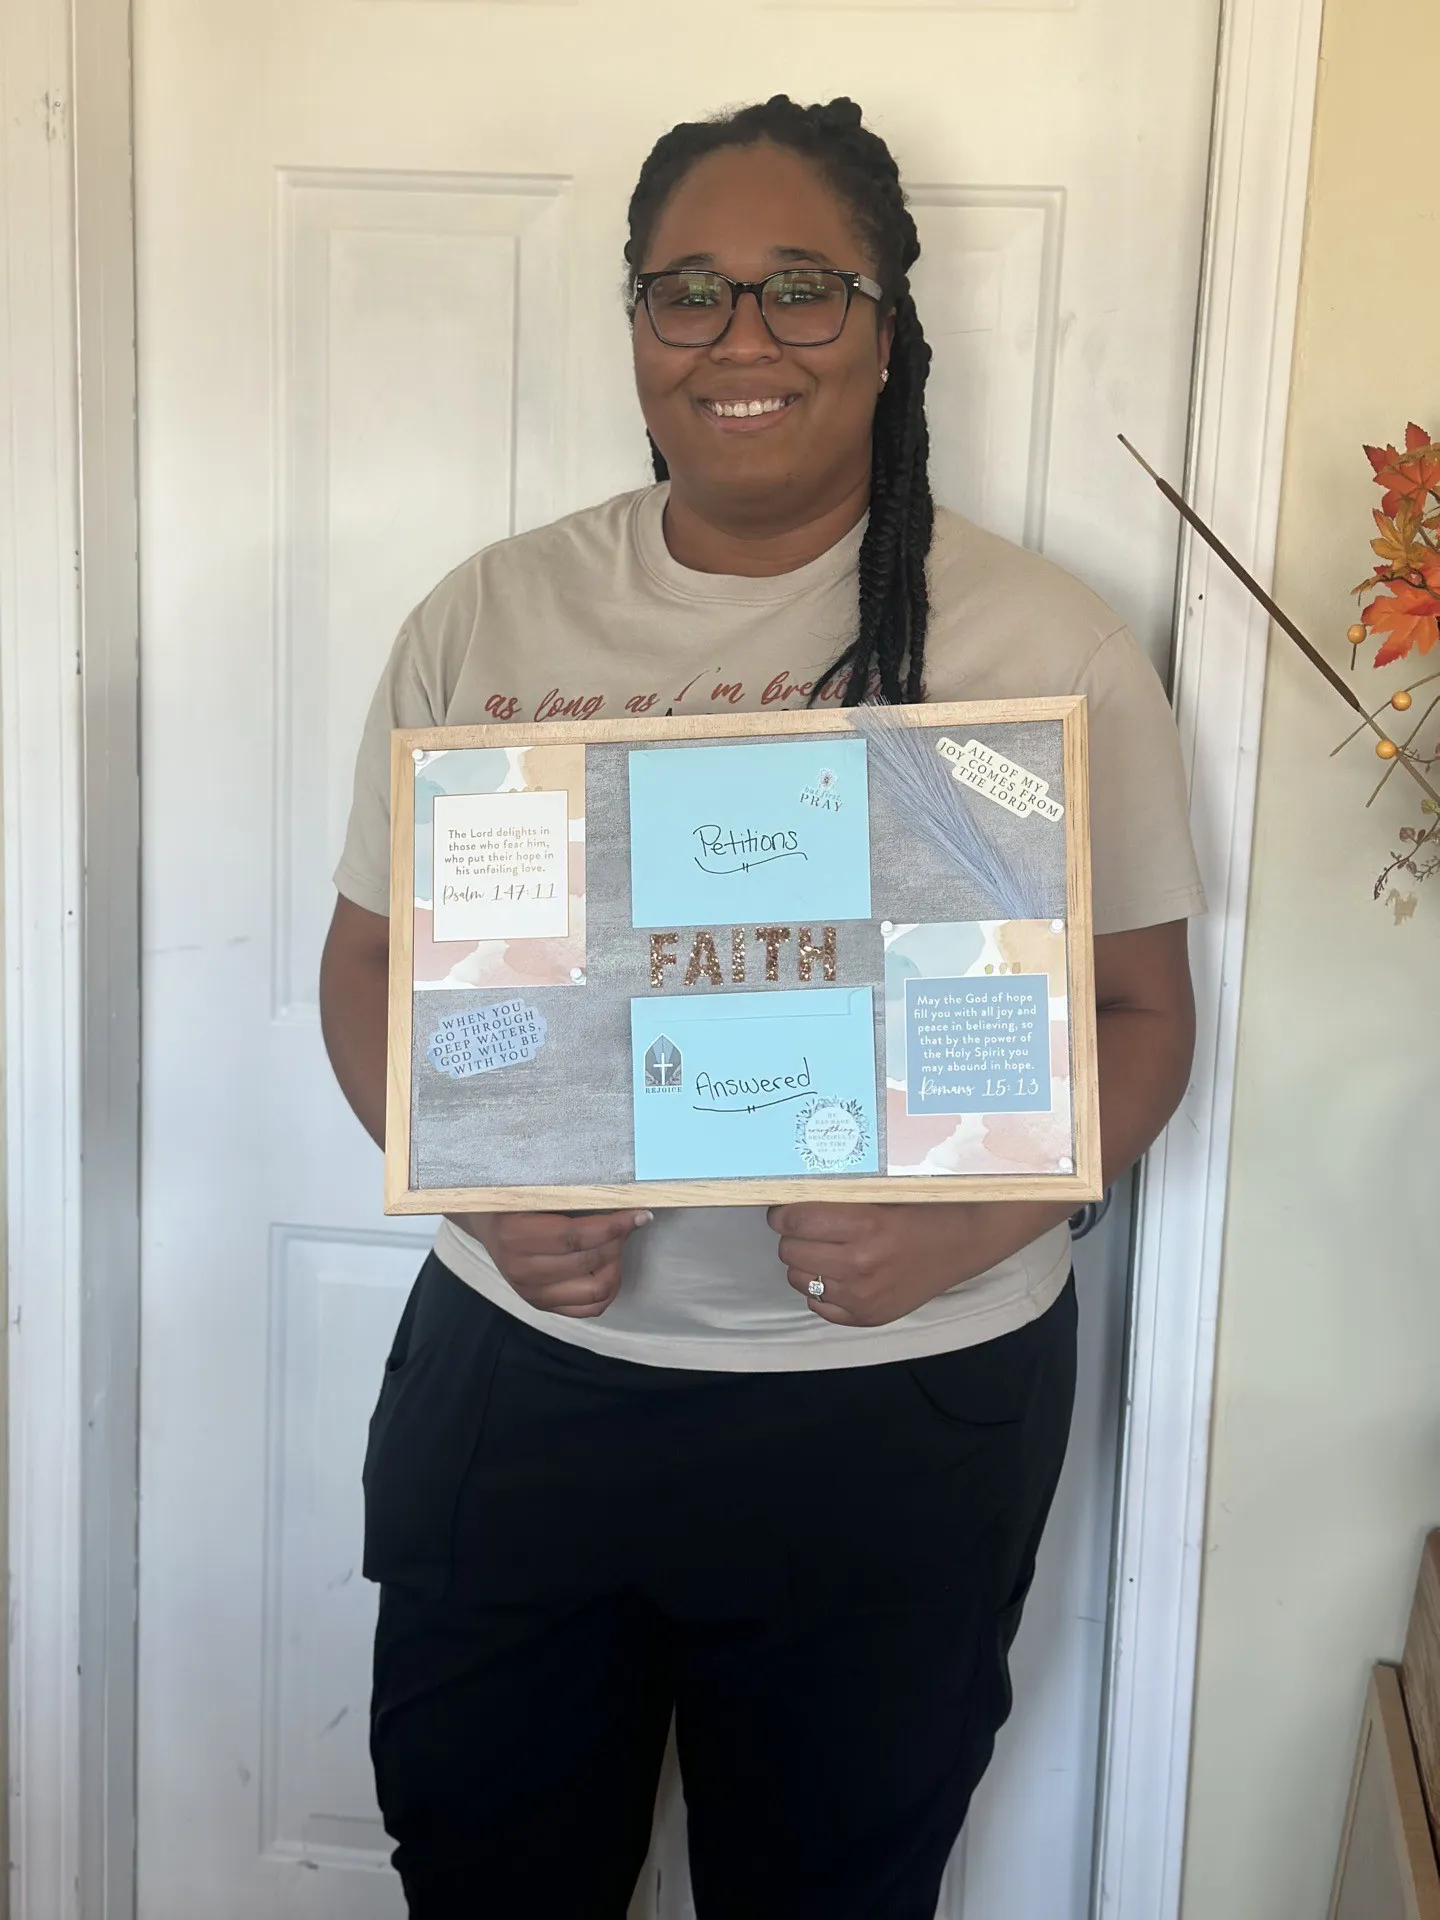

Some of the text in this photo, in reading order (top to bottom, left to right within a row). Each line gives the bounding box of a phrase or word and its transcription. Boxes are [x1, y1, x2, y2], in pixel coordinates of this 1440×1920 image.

[485, 694, 522, 720] as
[534, 688, 606, 722] long
[625, 693, 660, 713] as
[939, 742, 1059, 817] JOY COMES FROM
[968, 747, 1043, 792] ALL OF MY
[959, 767, 1027, 811] THE LORD
[800, 793, 843, 812] PRAY
[449, 826, 549, 839] The Lord delights in
[693, 824, 799, 857] Petitions
[449, 839, 549, 851] those who fear him,
[445, 851, 554, 865] who put their hope in
[456, 864, 545, 876] his unfailing love.
[443, 885, 484, 905] Psalm
[650, 926, 837, 988] FAITH
[918, 992, 1032, 1008] May the God of hope
[442, 1002, 520, 1029] WHEN YOU
[914, 1005, 1036, 1021] fill you with all joy and
[435, 1011, 534, 1044] GO THROUGH
[918, 1020, 1034, 1035] peace in believing, so
[433, 1023, 541, 1057] DEEP WATERS,
[440, 1034, 538, 1066] GOD WILL BE
[920, 1032, 1032, 1047] that by the power of
[454, 1048, 528, 1074] WITH YOU
[924, 1048, 1028, 1060] the Holy Spirit you
[696, 1057, 811, 1100] Answered
[922, 1060, 1034, 1075] may abound in hope.
[645, 1086, 683, 1094] REJOICE
[918, 1076, 975, 1101] Romans
